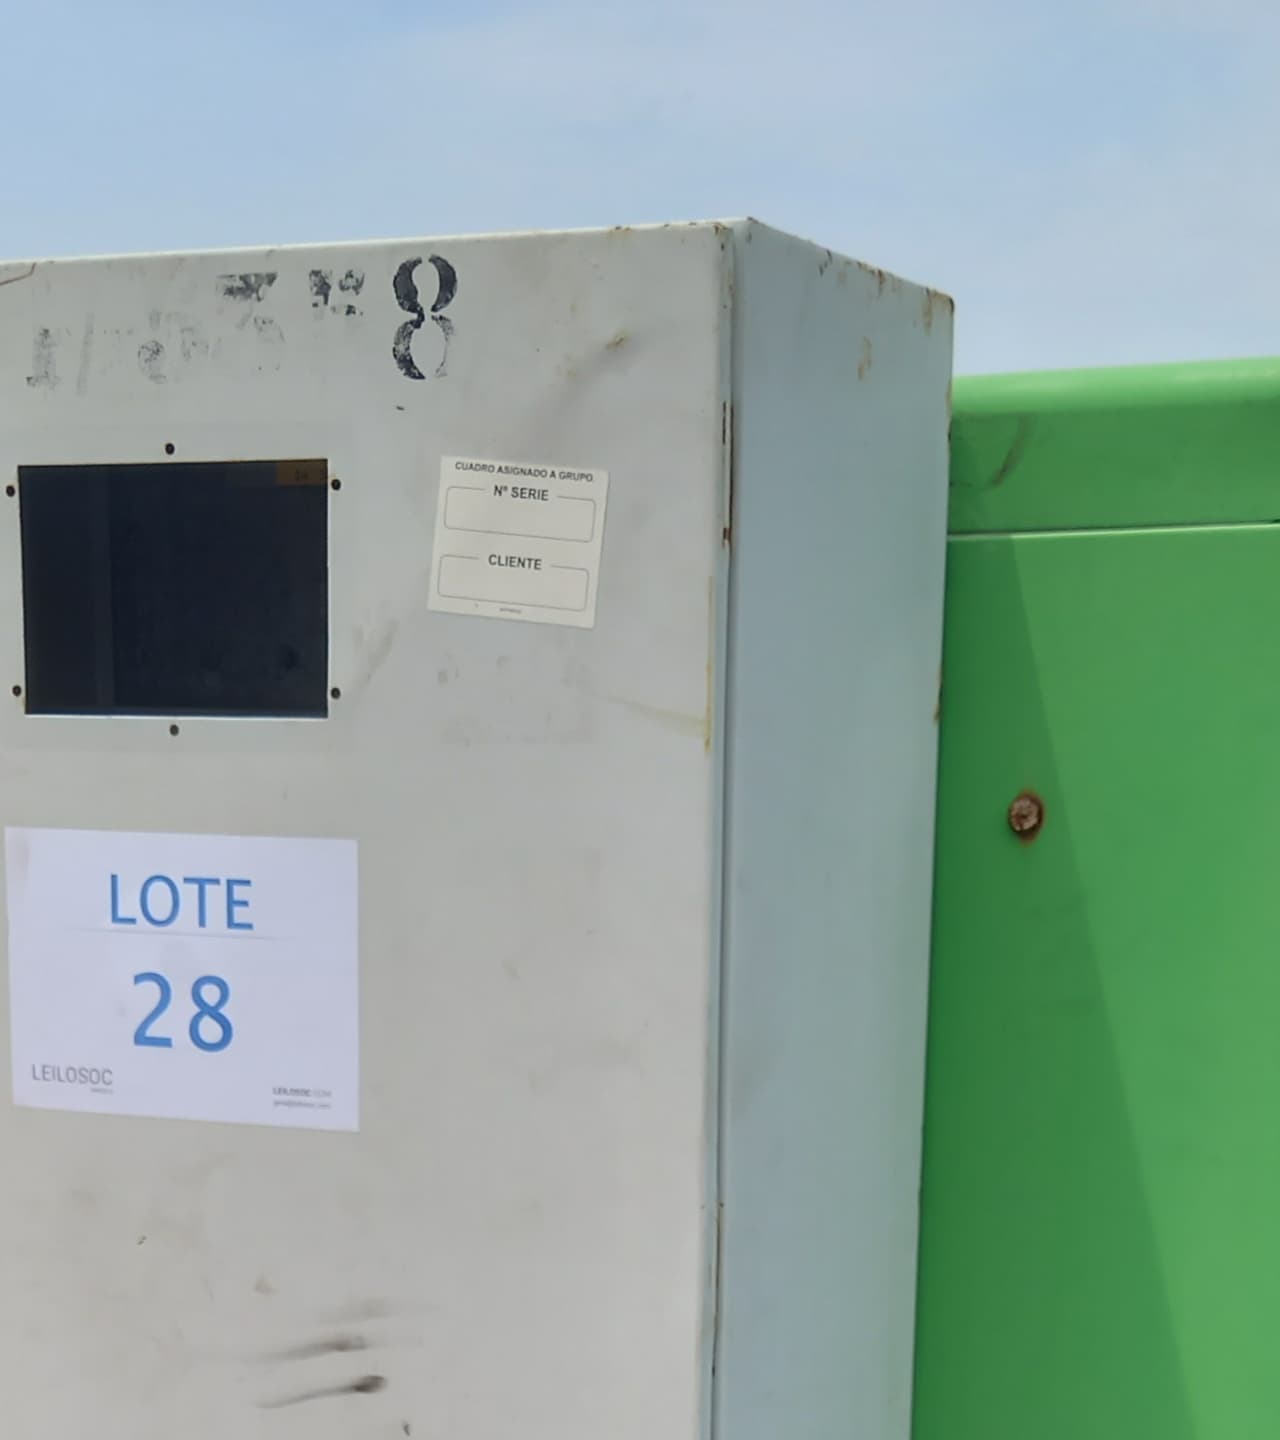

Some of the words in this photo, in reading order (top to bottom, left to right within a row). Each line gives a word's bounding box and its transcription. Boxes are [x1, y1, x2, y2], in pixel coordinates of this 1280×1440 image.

[454, 461, 496, 474] CUADRO
[496, 465, 548, 479] ASIGNADO
[549, 470, 557, 479] A
[558, 471, 594, 483] GRUPO
[510, 487, 550, 501] SERIE
[487, 554, 543, 571] CLIENTE
[110, 873, 255, 931] LOTE
[132, 971, 235, 1053] 28
[32, 1063, 114, 1086] LEILOSOC
